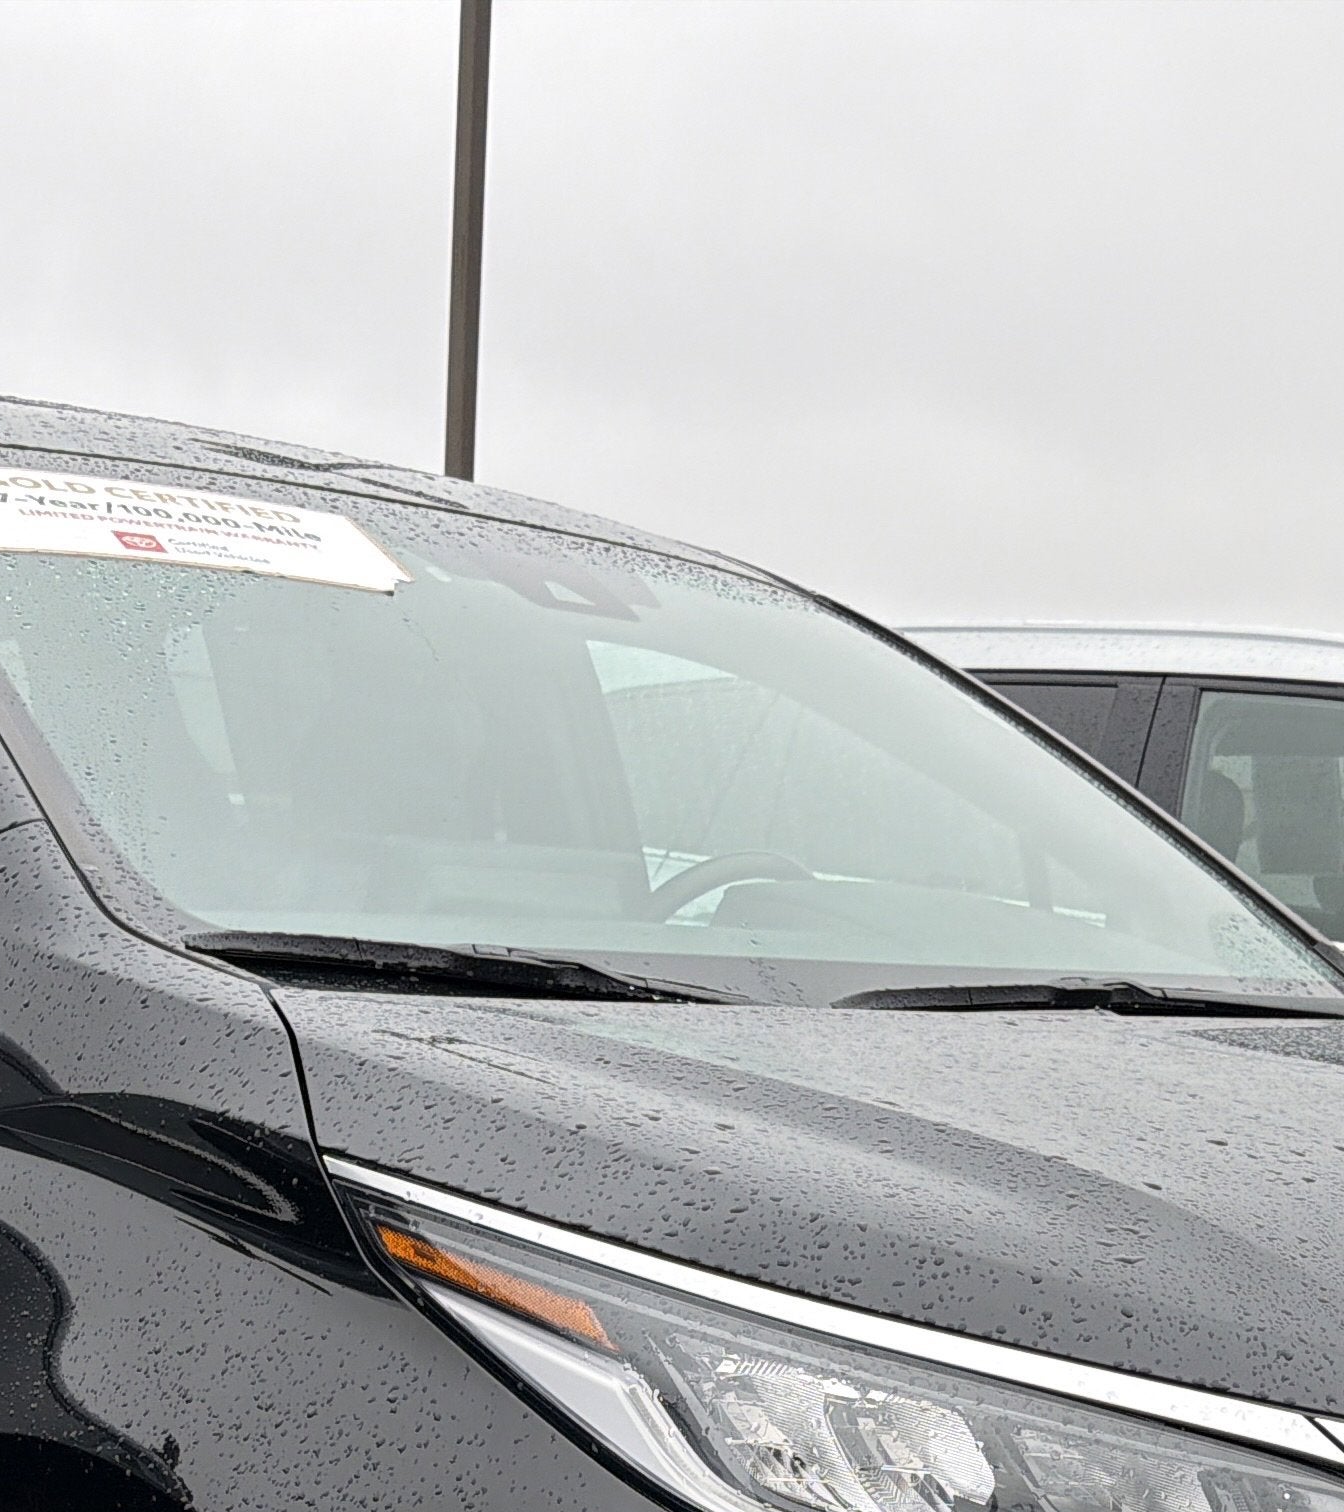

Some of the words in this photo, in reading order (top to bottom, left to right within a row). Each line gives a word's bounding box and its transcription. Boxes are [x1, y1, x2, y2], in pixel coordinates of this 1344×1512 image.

[104, 486, 301, 523] CERTIFIED
[18, 508, 94, 521] LIMITED
[97, 515, 220, 536] POWERTRAIN
[221, 529, 319, 551] WARRANTY
